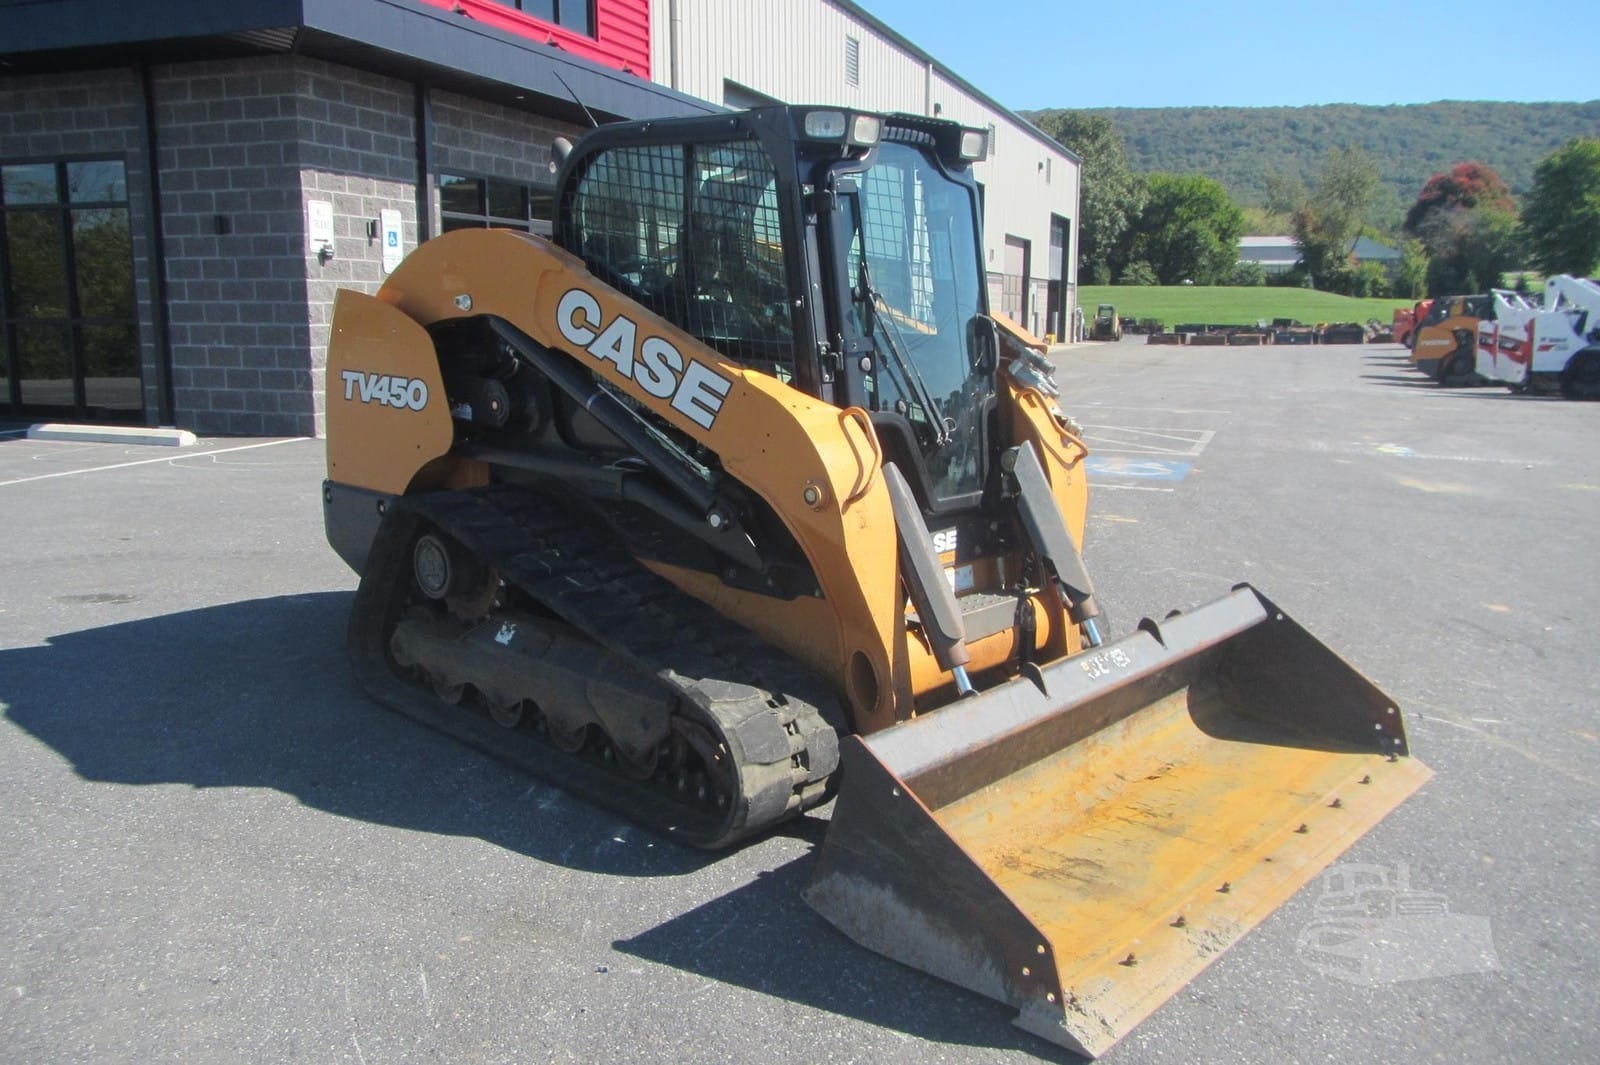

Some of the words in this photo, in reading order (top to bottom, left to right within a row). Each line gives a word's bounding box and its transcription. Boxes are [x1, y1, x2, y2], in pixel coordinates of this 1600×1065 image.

[556, 288, 733, 431] CASE
[341, 369, 428, 412] TV450
[933, 530, 957, 553] SE
